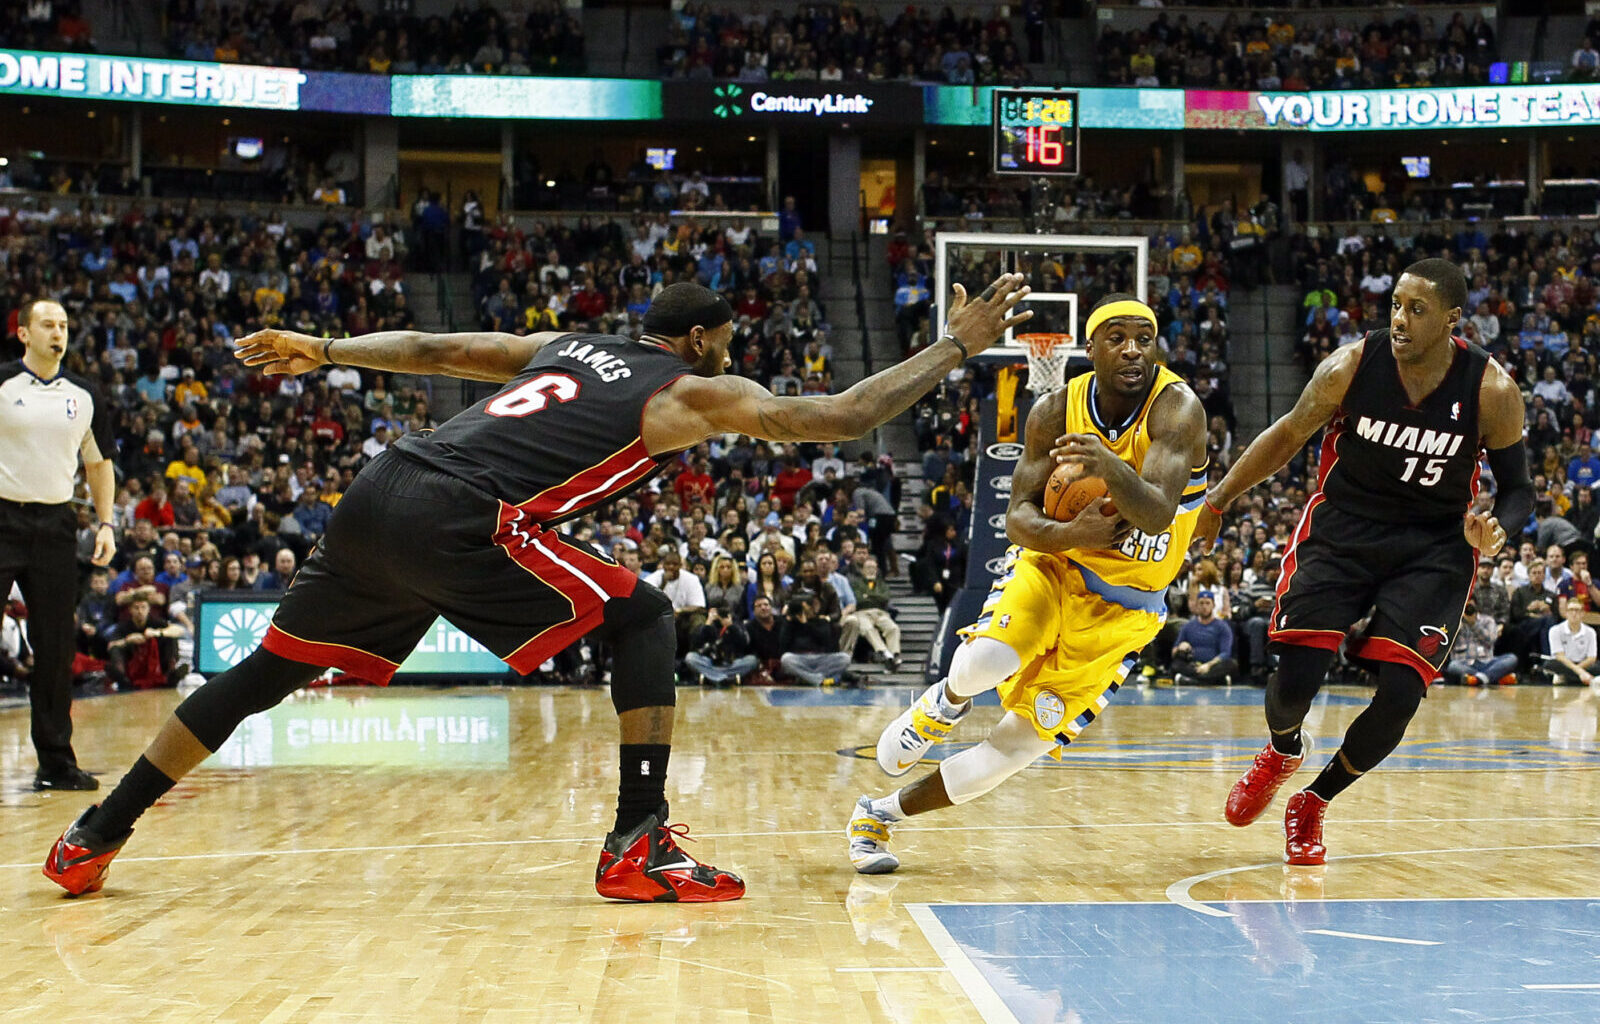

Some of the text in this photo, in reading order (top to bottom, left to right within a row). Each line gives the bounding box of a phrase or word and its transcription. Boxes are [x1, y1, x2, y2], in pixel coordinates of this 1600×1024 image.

[100, 60, 307, 109] INTERNET
[751, 92, 869, 115] CenturyLink
[1258, 94, 1369, 126] YOUR
[1381, 91, 1498, 123] HOME
[1026, 125, 1064, 165] 16
[557, 340, 632, 383] JAMES
[484, 372, 582, 418] 6
[1108, 429, 1118, 442] D
[1356, 416, 1464, 456] MIAMI
[1400, 457, 1448, 486] 15
